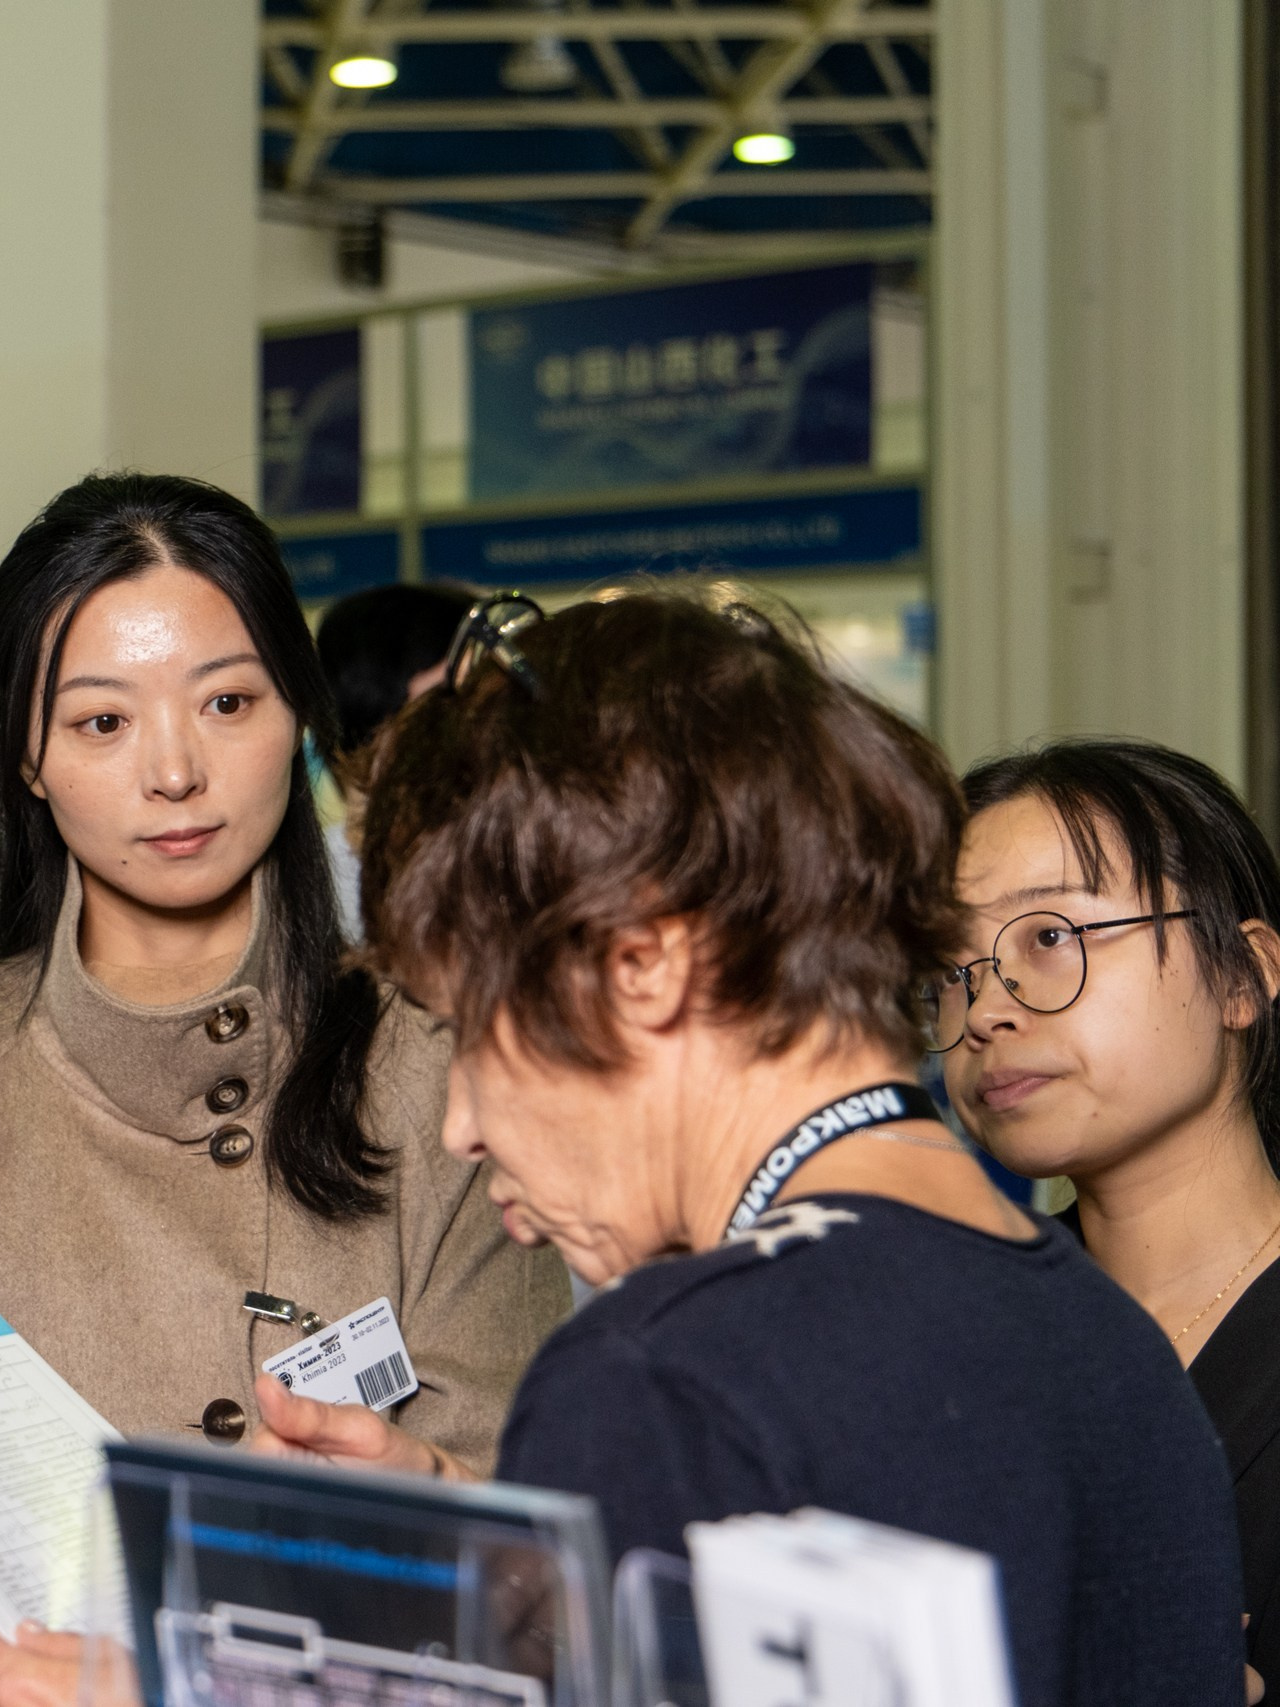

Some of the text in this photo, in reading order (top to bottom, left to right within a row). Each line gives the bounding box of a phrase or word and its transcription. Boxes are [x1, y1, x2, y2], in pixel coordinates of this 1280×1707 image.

[297, 1341, 342, 1371] Химия-2023
[301, 1353, 347, 1384] Khimia 2023
